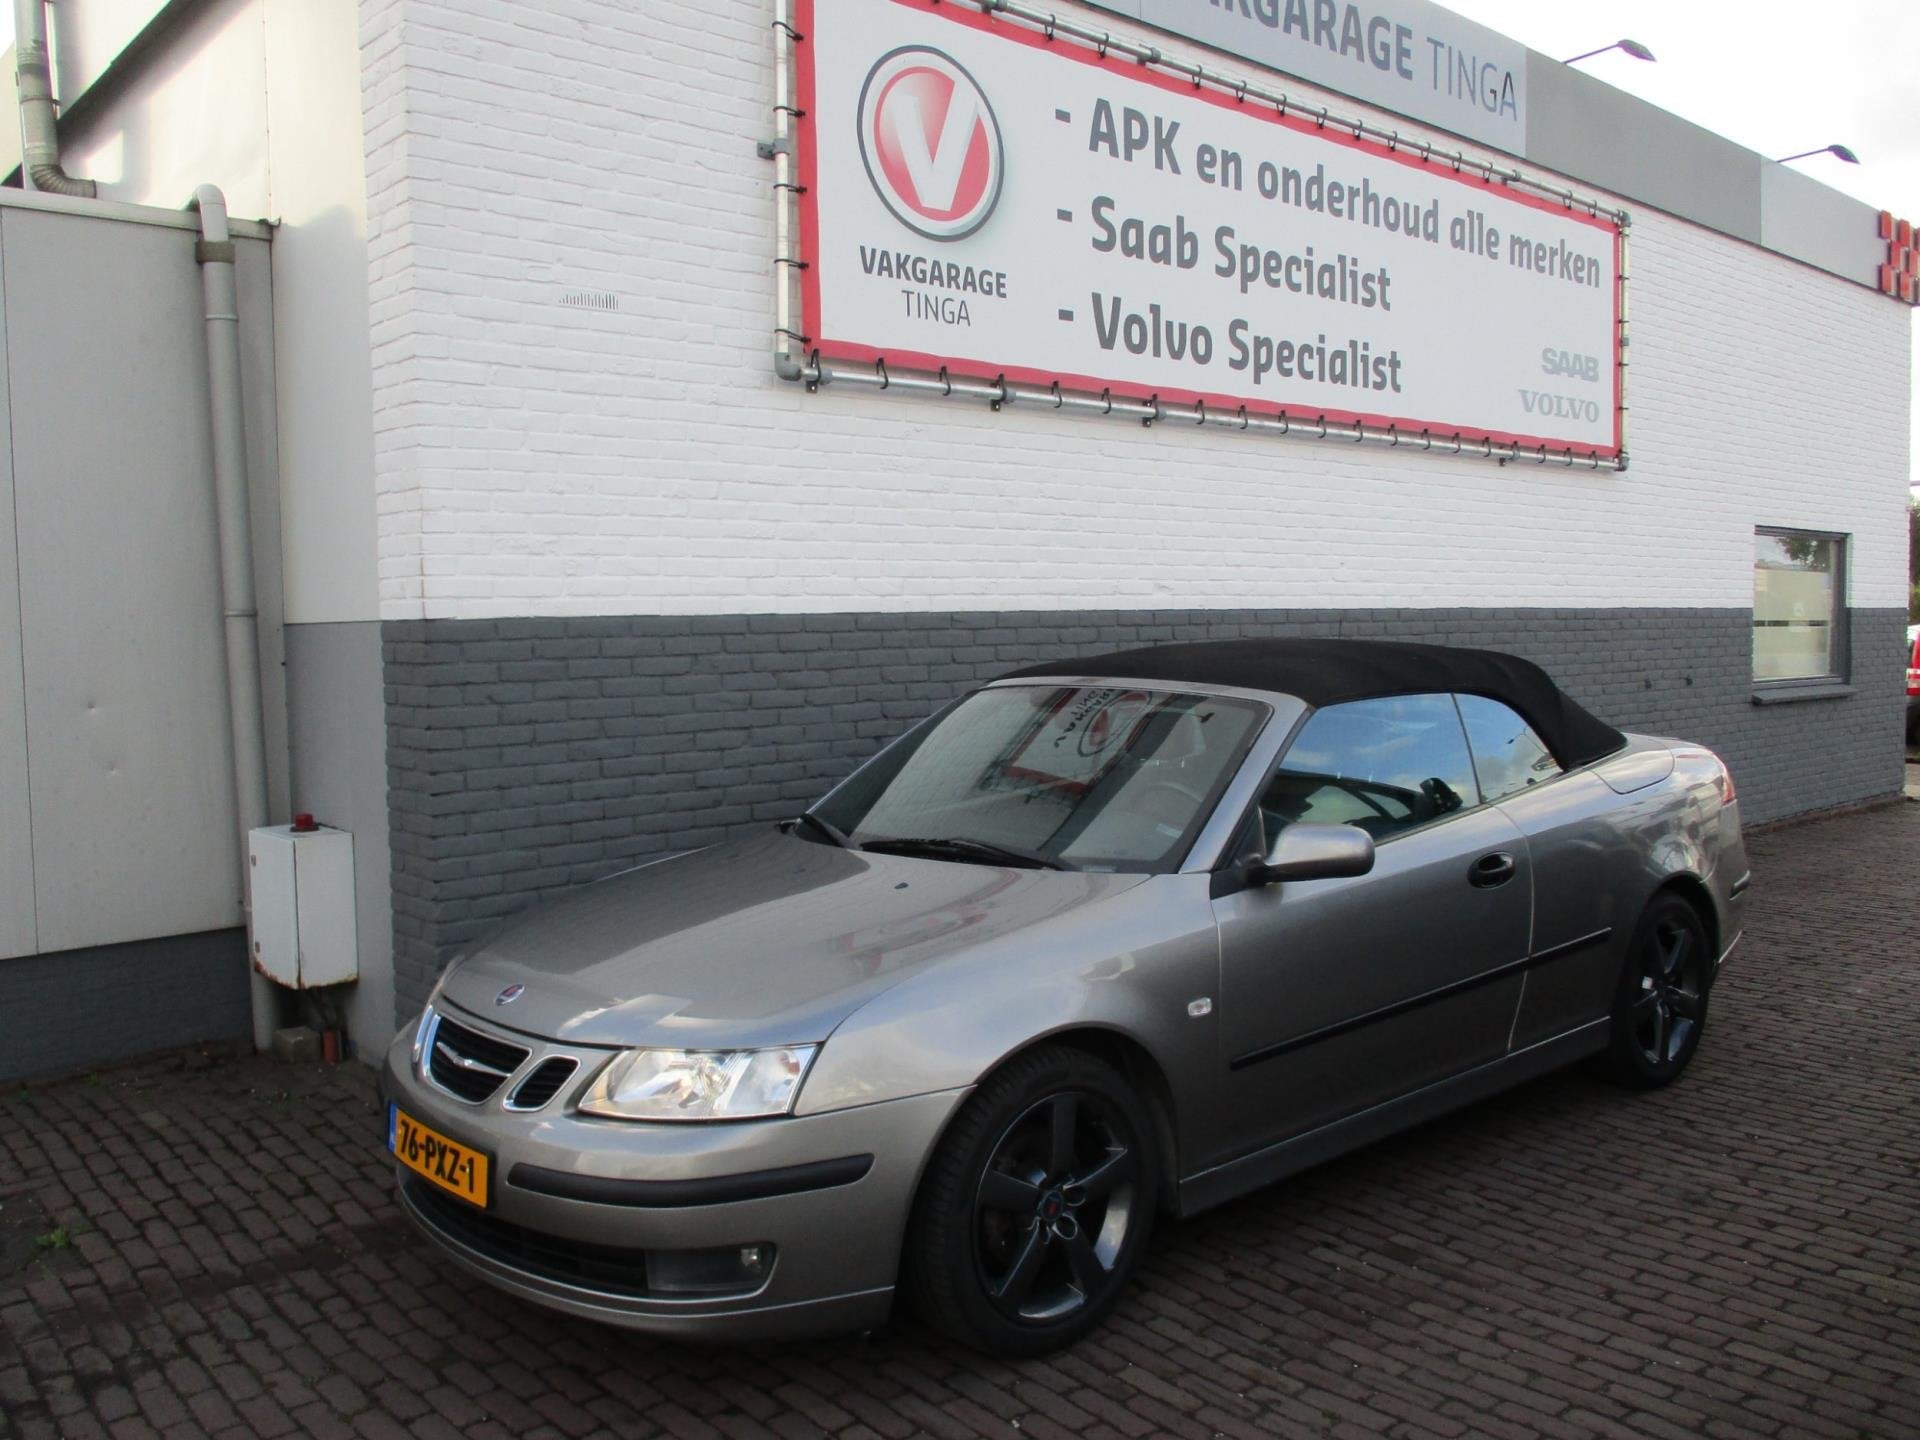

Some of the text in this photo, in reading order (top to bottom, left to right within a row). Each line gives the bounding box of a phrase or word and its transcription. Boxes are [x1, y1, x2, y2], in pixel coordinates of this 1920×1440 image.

[1426, 36, 1517, 122] TINGA
[1088, 97, 1182, 175] APK
[1196, 143, 1243, 191] en
[1257, 160, 1439, 244] onderhoud
[1450, 209, 1500, 261] alle
[1509, 233, 1600, 289] merken
[859, 245, 1007, 298] VAKGARAGE
[1091, 195, 1199, 270] Saab
[1214, 225, 1391, 312] Specialist
[901, 289, 971, 327] TINGA
[1091, 291, 1213, 366] Volvo
[1228, 318, 1401, 394] Specialist
[1541, 347, 1599, 383] SAAB
[1517, 388, 1600, 423] VOLVO
[400, 1119, 474, 1194] 76-PXZ-1
